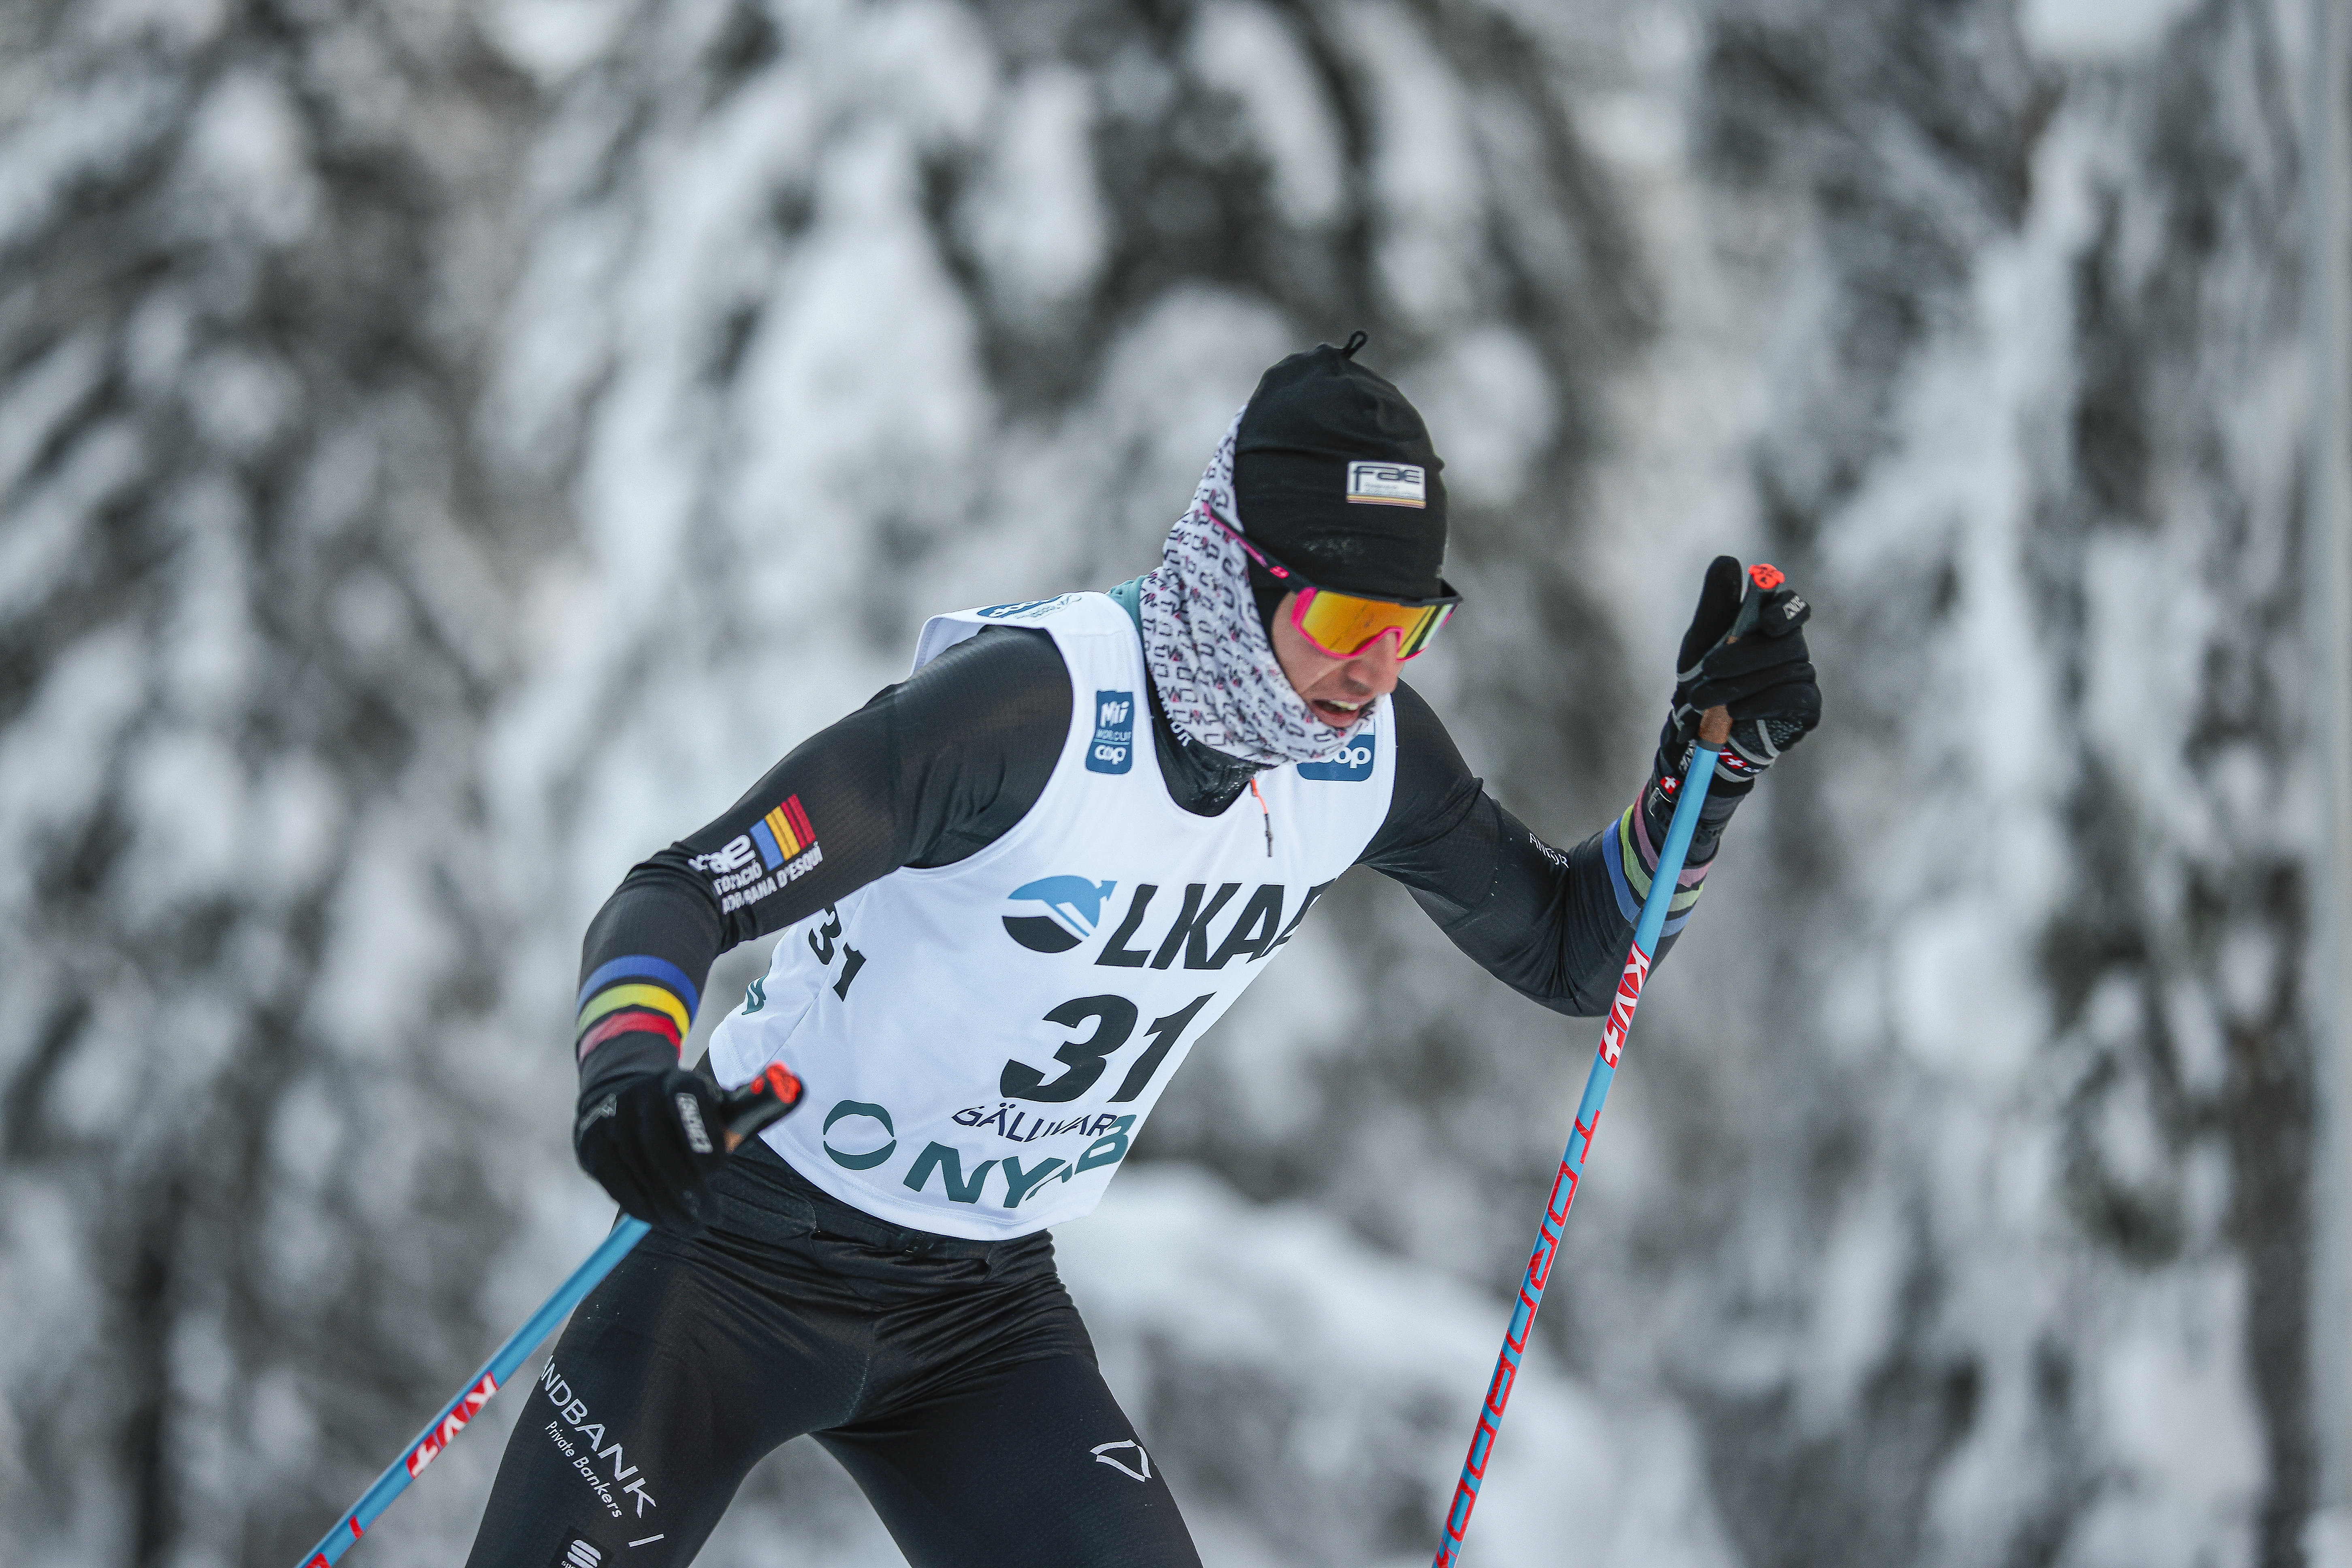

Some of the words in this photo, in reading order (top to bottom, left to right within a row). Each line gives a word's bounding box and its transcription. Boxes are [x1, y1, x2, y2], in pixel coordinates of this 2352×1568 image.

[1094, 745, 1127, 765] coop
[809, 906, 866, 1002] 31
[1000, 991, 1217, 1103] 31
[1445, 1109, 1601, 1543] TORNADO
[545, 1421, 575, 1457] Private
[572, 1456, 622, 1518] Bankers
